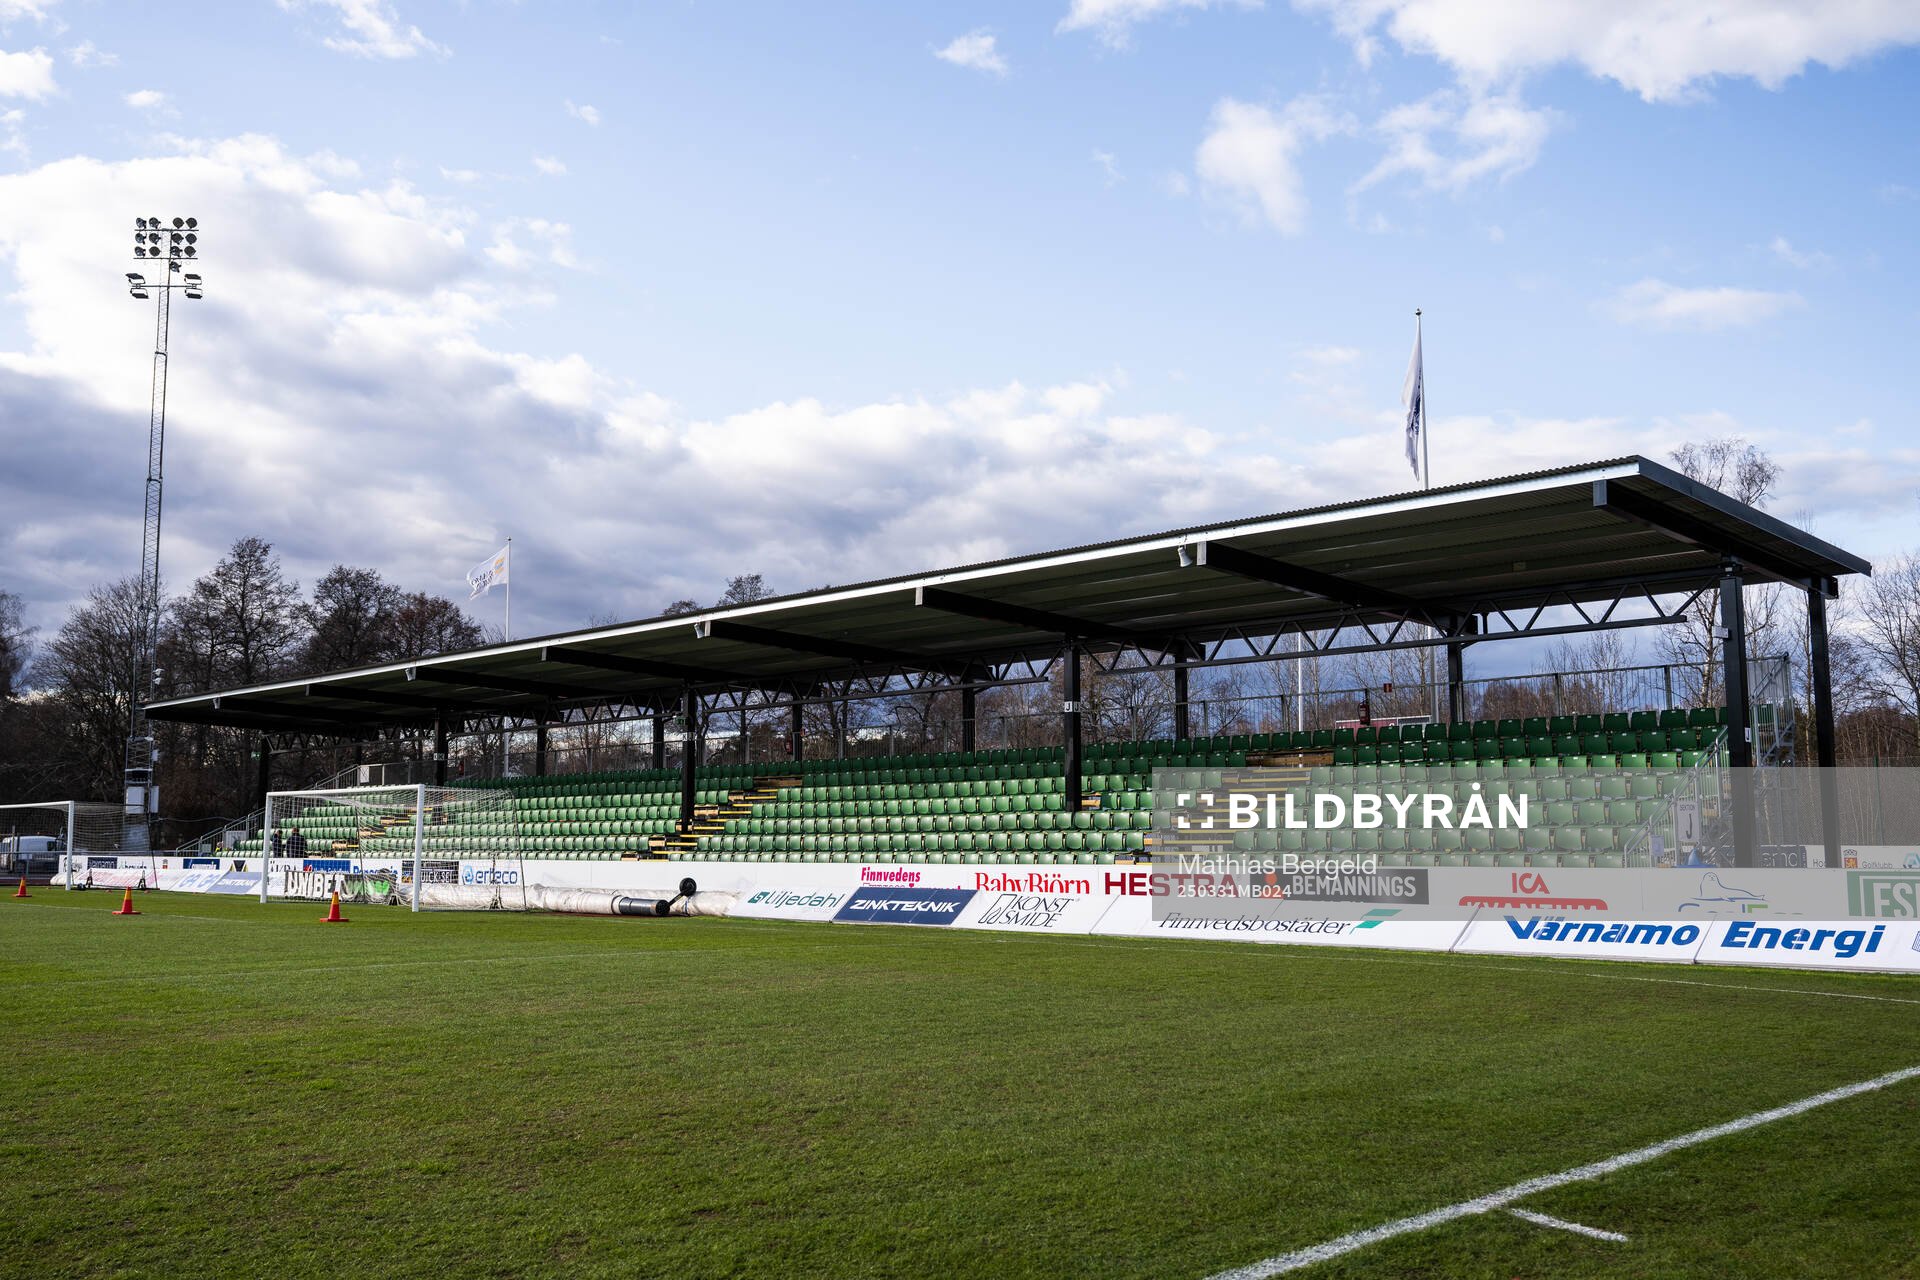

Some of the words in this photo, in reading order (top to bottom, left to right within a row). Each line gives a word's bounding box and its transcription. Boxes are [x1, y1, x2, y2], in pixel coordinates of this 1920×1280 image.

[1685, 813, 1693, 839] J
[287, 870, 346, 898] UNIBET
[475, 867, 518, 884] erteco
[861, 866, 921, 883] Finnvedens
[1105, 872, 1242, 898] HESTRA
[1511, 872, 1551, 895] ICA
[1292, 875, 1417, 897] BEMANNINGS
[850, 899, 961, 913] ZINKTEKNIK
[1011, 895, 1075, 913] KONST
[999, 910, 1063, 928] SMIDE
[1158, 911, 1351, 936] Finnvedsbostäder
[1503, 915, 1700, 946] Värnamo
[1720, 920, 1887, 958] Energi
